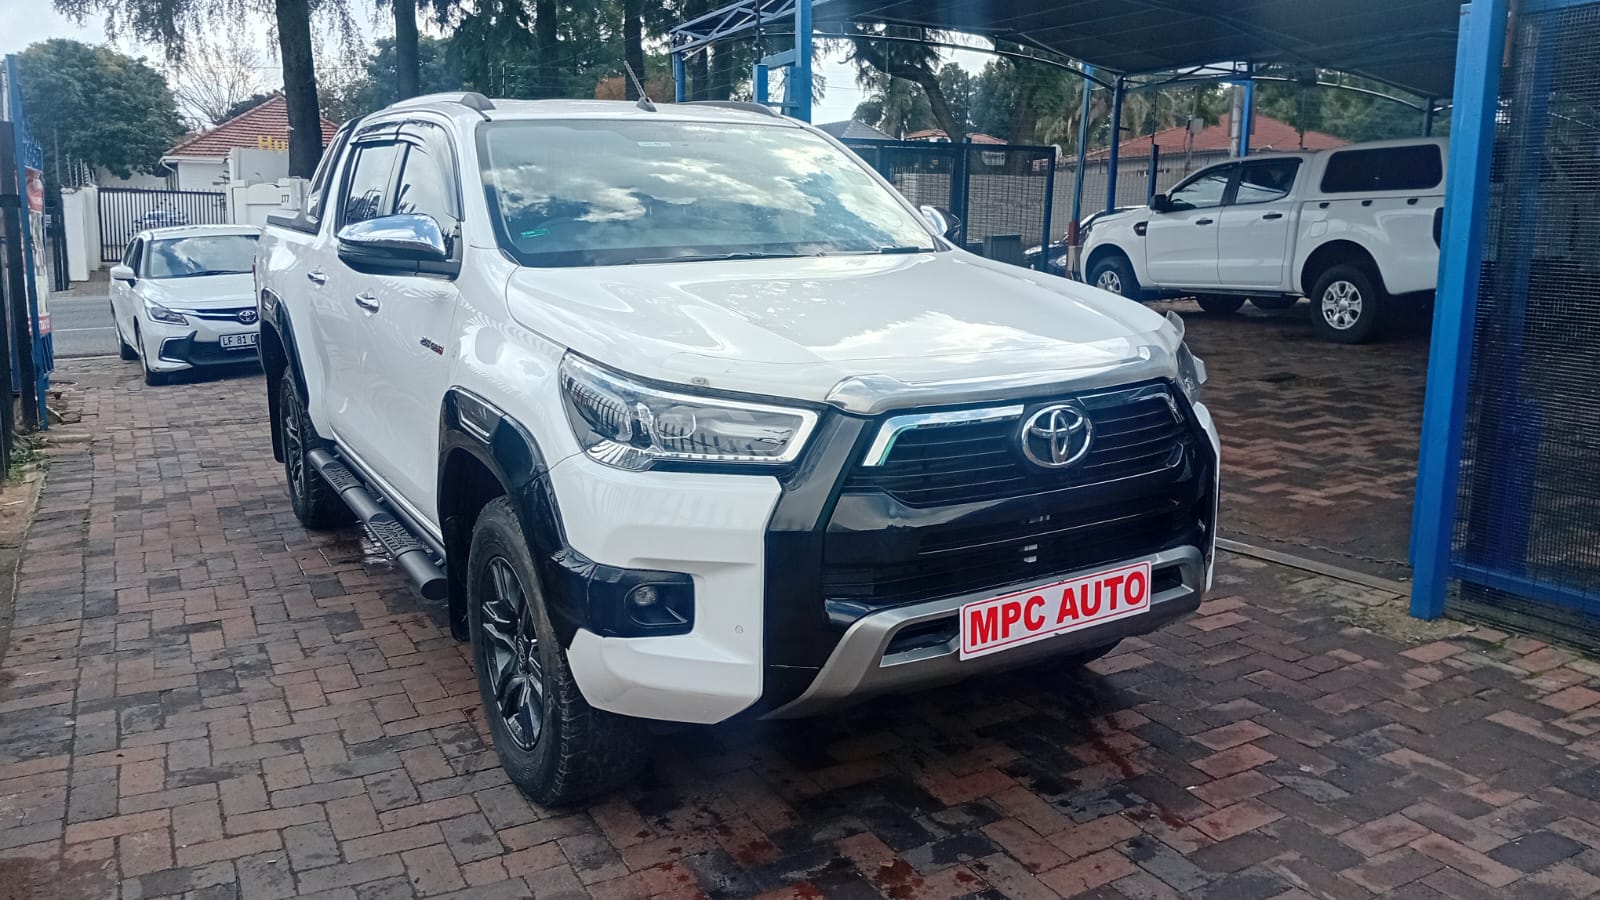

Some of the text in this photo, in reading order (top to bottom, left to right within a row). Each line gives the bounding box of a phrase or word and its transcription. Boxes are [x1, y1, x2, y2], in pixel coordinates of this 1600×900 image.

[222, 336, 233, 346] LF
[236, 335, 247, 345] 81
[970, 571, 1146, 647] MPC AUTO
